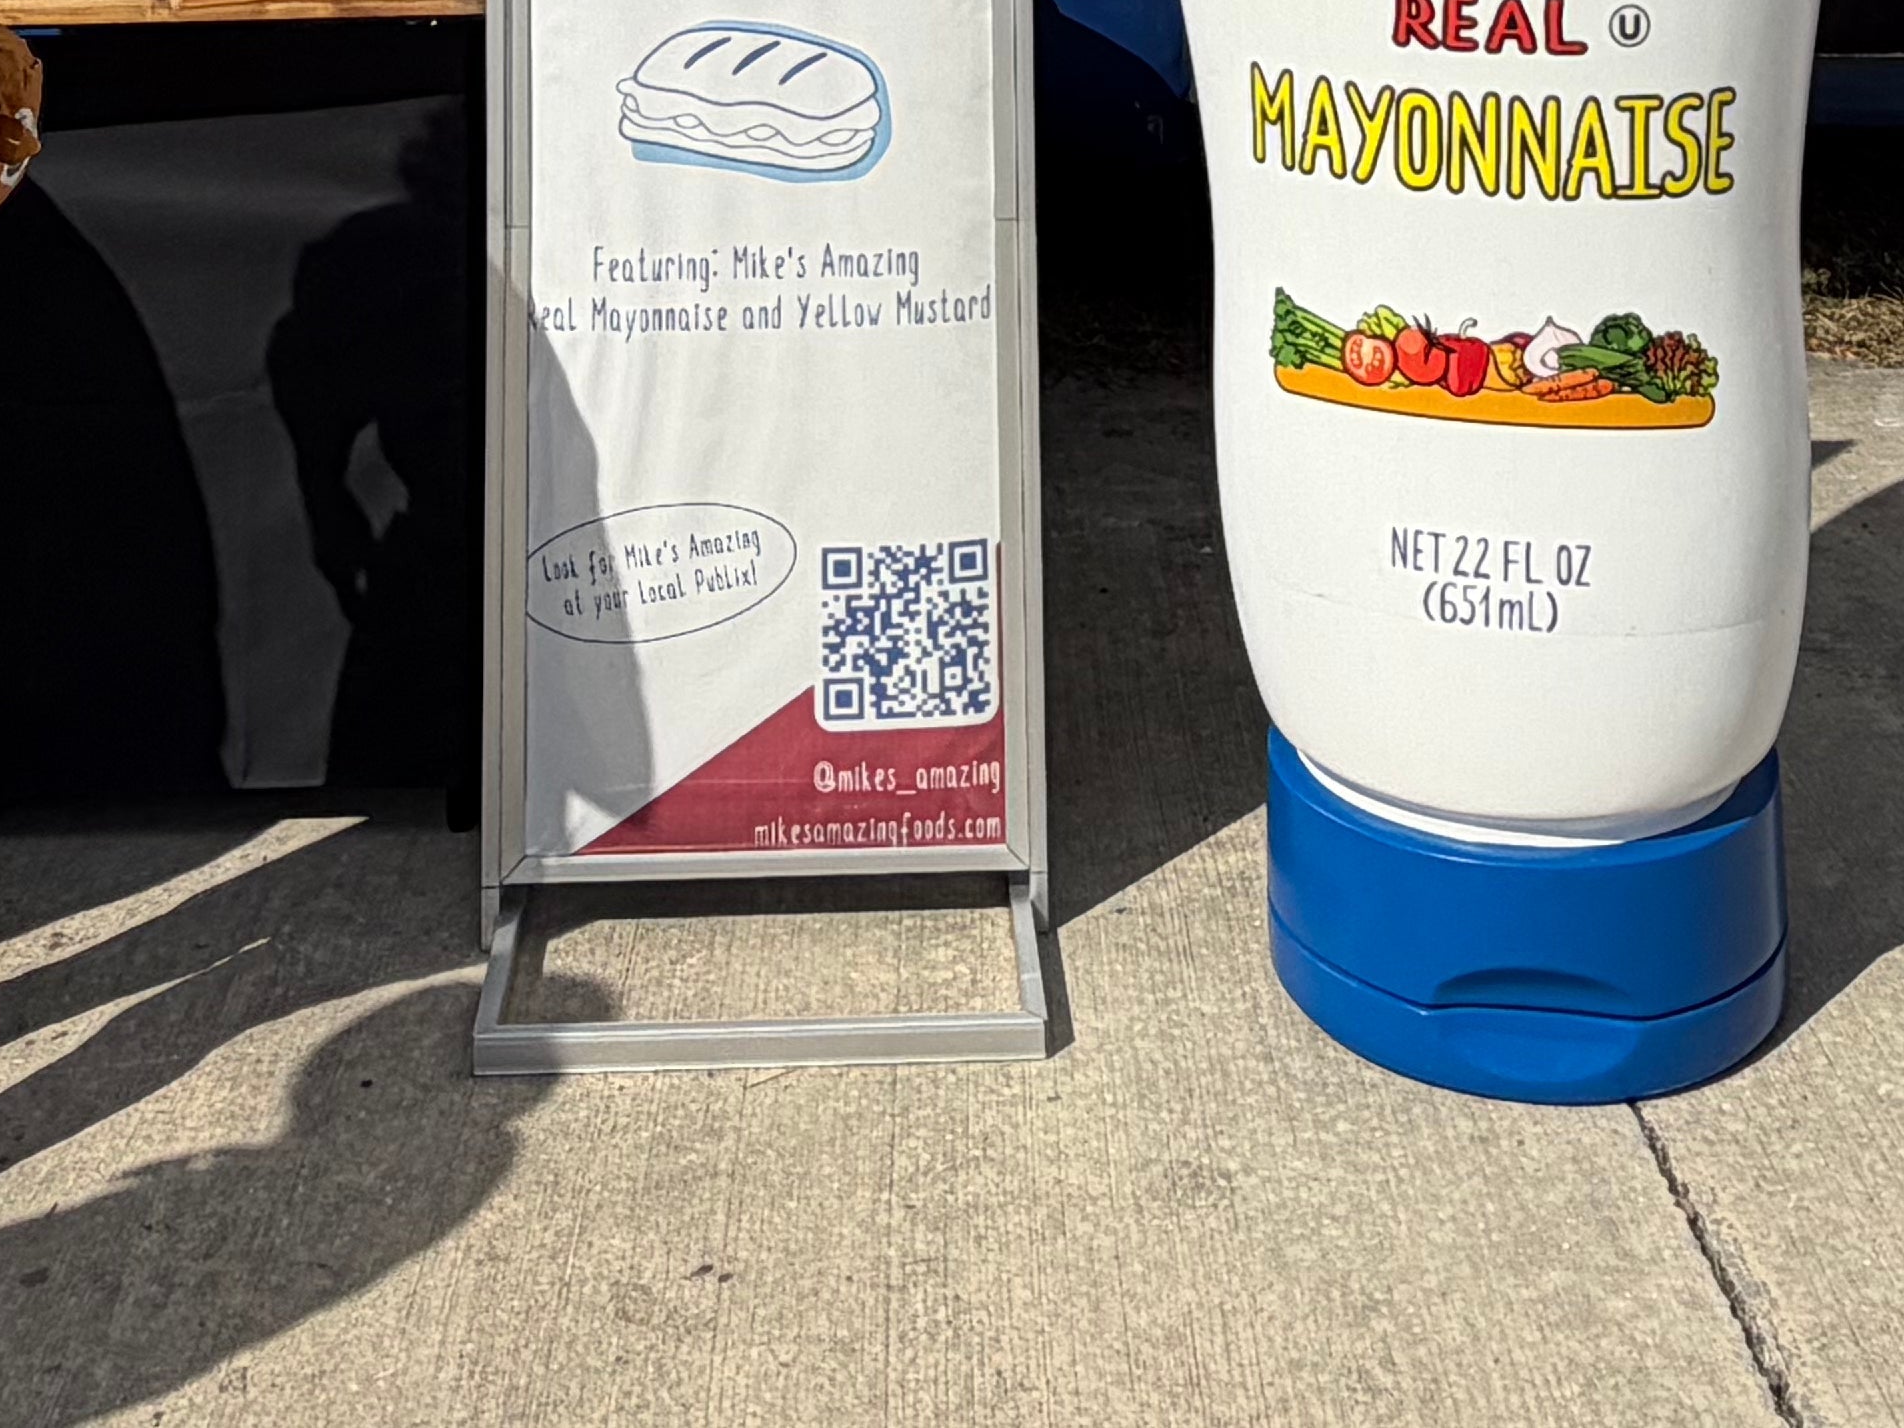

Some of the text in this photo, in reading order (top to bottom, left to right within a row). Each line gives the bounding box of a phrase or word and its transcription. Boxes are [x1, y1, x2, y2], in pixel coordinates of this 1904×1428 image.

[1249, 61, 1738, 201] MAYONNAISE
[592, 242, 920, 292] Featuring: Mike's Amazing
[590, 295, 728, 343] Mayonnaise
[742, 294, 782, 330] and
[796, 293, 883, 329] Yellow
[895, 283, 993, 326] Mustard
[588, 550, 614, 586] for
[624, 540, 680, 571] Mike's
[688, 529, 762, 561] Amazing
[1391, 526, 1592, 588] NET 22 FL OZ
[563, 590, 584, 616] at
[594, 590, 628, 621] your
[813, 760, 1002, 796] @mikes_amazing
[753, 811, 1003, 847] mikesamazingfoods.com
